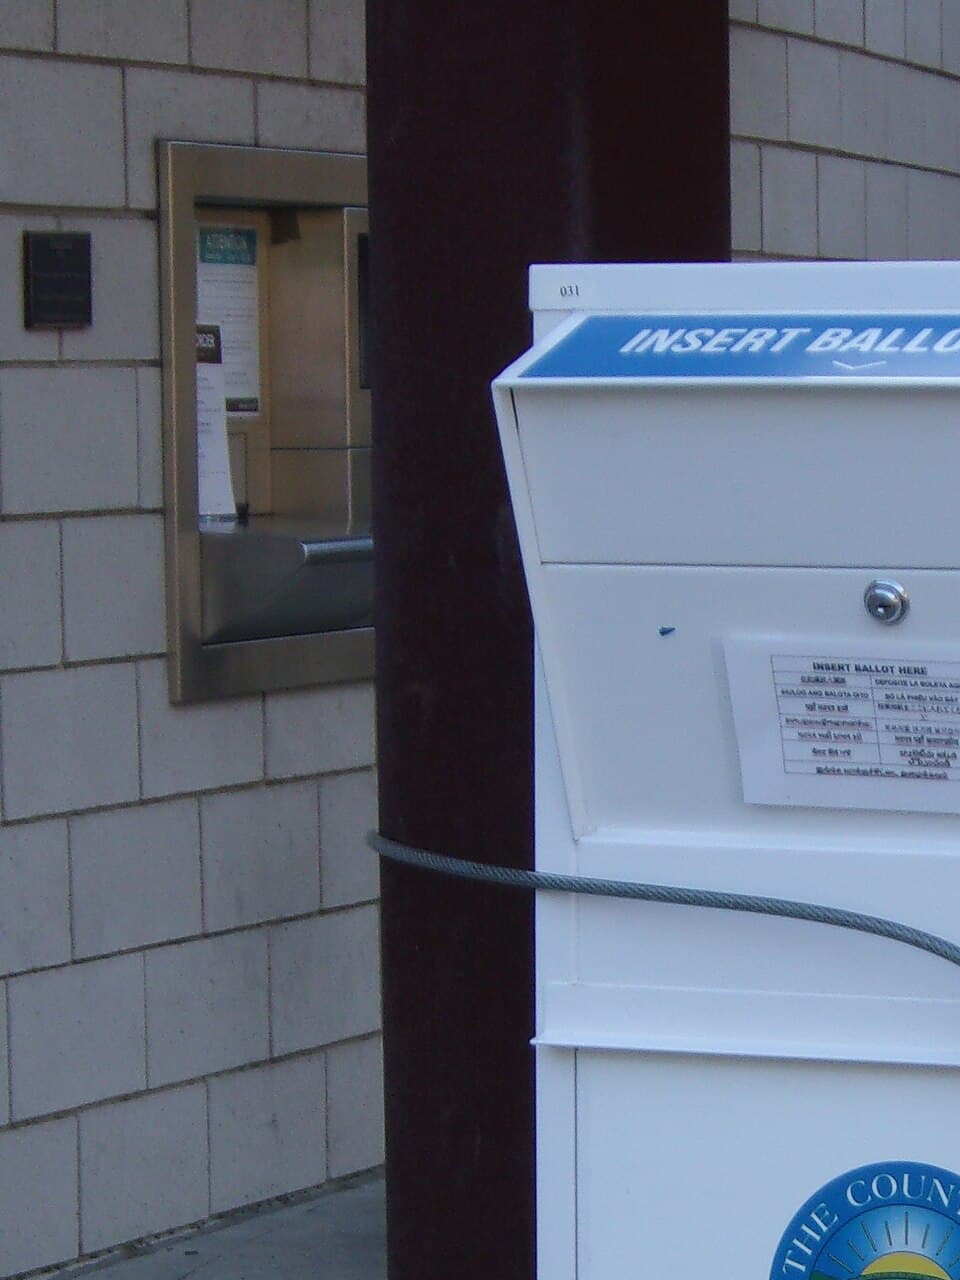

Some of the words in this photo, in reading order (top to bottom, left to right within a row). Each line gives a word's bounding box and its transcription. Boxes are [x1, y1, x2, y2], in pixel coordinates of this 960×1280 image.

[560, 284, 579, 297] 031
[619, 327, 809, 354] INSERT
[812, 662, 851, 673] INSERT
[855, 663, 895, 675] BALLOT
[898, 665, 928, 676] HERE
[782, 1202, 839, 1275] THE
